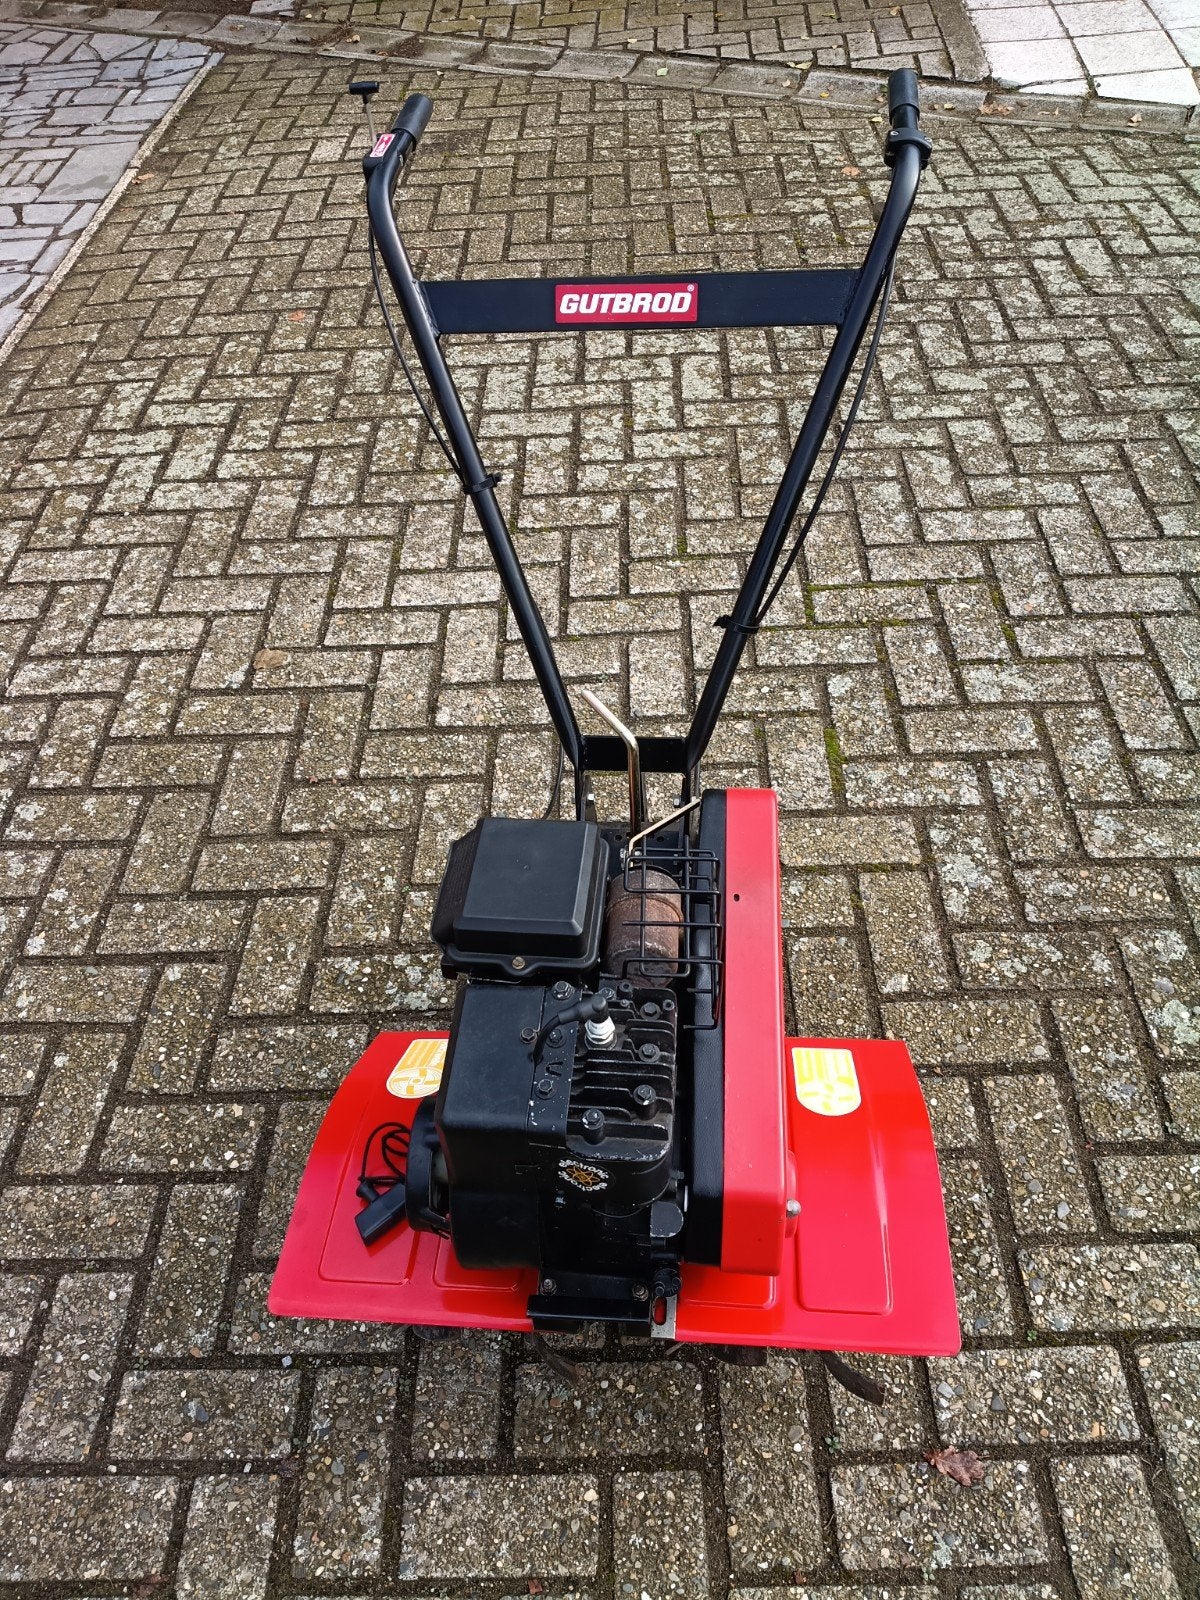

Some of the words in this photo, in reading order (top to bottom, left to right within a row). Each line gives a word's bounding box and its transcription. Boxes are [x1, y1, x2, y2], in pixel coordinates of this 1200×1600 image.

[559, 292, 692, 314] GUTBROD
[558, 1159, 609, 1179] electronic
[558, 1171, 608, 1191] electronic
